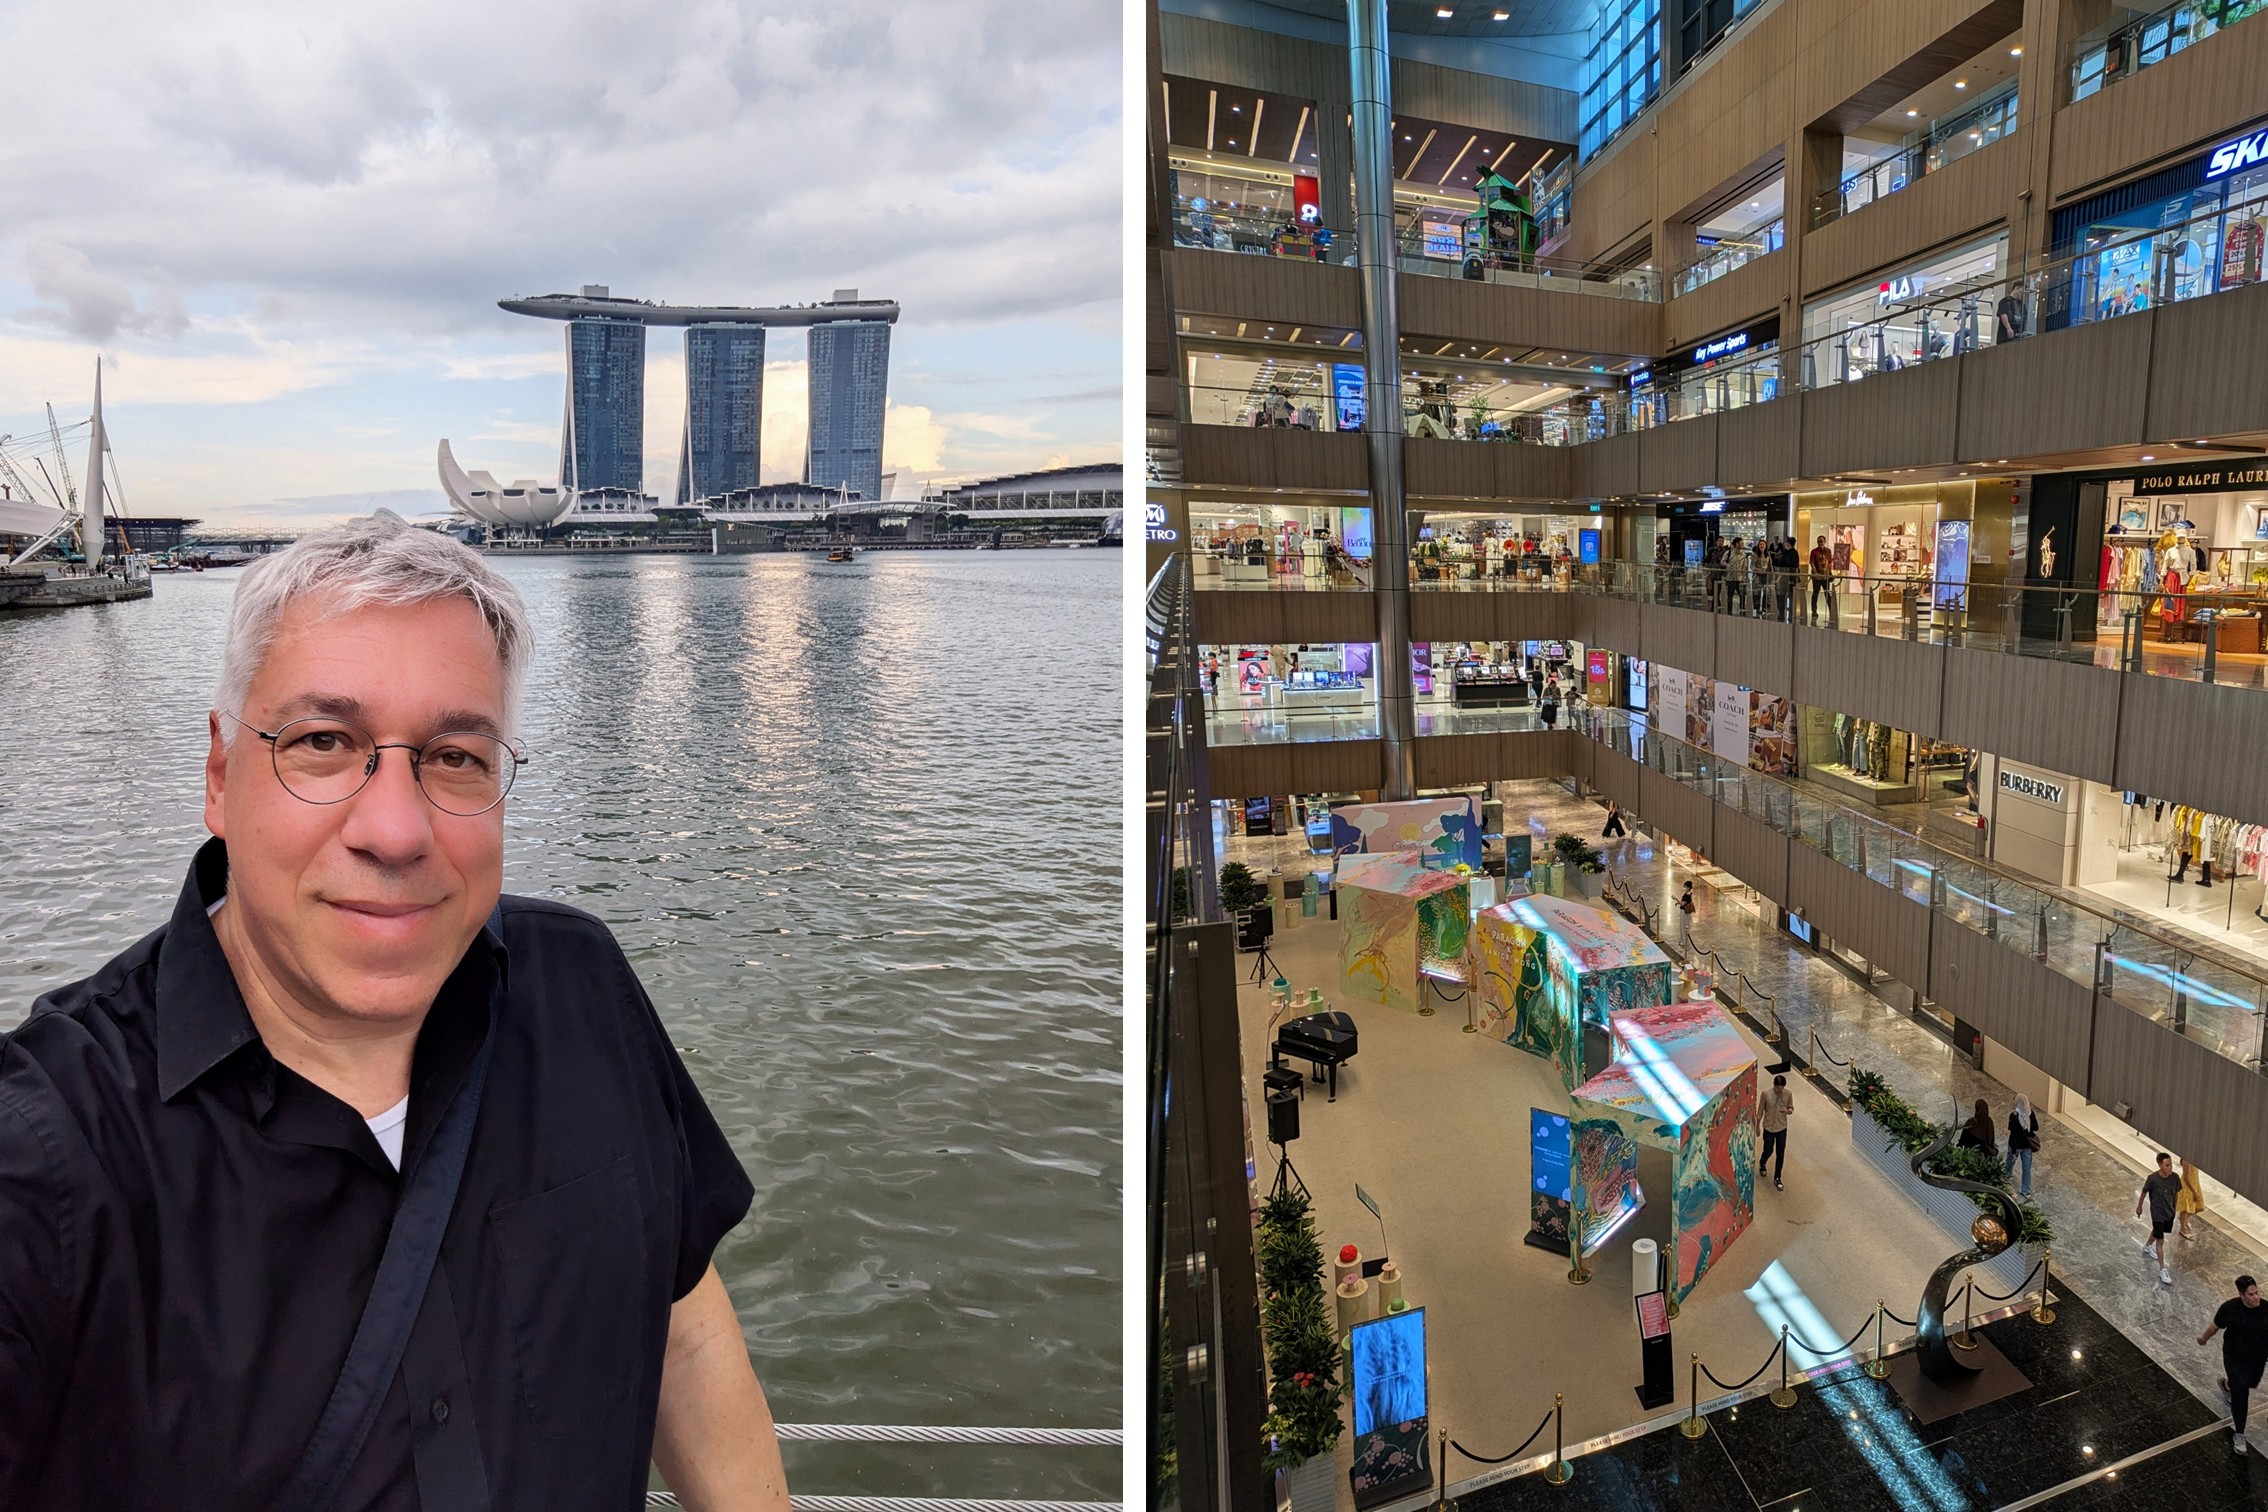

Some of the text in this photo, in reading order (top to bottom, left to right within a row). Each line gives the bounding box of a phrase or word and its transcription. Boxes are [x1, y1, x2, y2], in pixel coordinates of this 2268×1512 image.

[2207, 132, 2268, 178] SK
[1879, 276, 1911, 304] FILA
[1707, 340, 1727, 355] Power
[1726, 333, 1747, 350] Sports
[2142, 476, 2172, 489] POLO
[2177, 472, 2220, 487] RALPH
[1146, 529, 1177, 540] ETRO
[1412, 648, 1428, 657] IOR
[1662, 683, 1683, 696] COACH
[1718, 700, 1744, 716] COACH
[2000, 770, 2063, 803] BURBERRY
[1492, 930, 1526, 948] PARAGON
[1484, 947, 1536, 970] JANICE WONG
[1701, 1390, 1753, 1411] PLEASE MIND YOUR STEP
[1591, 1438, 1609, 1448] PLEASE
[1622, 1429, 1635, 1438] YOUR
[1635, 1425, 1647, 1434] STEP
[1470, 1463, 1531, 1488] PLEASE MIND YOUR STEP
